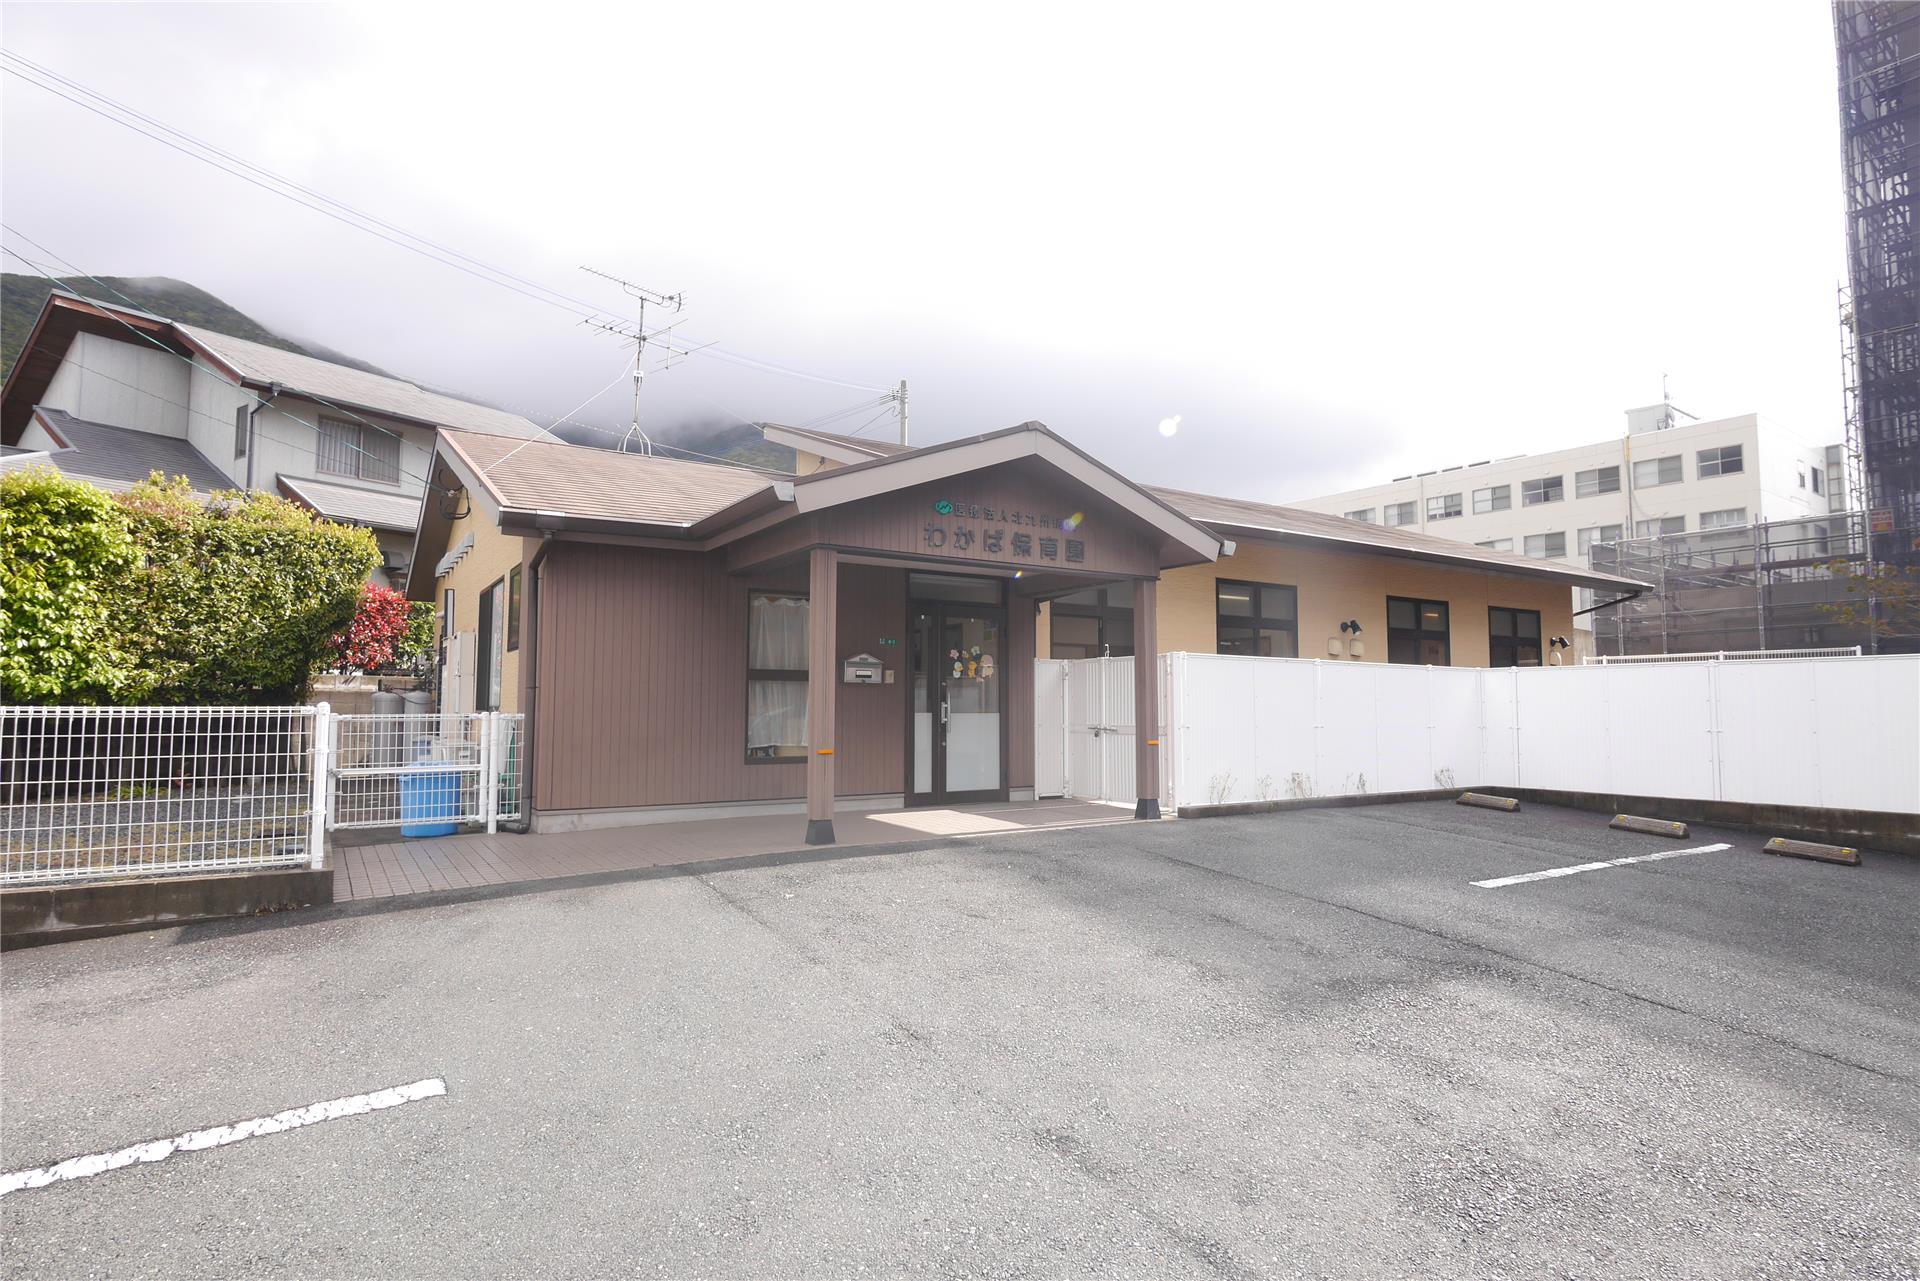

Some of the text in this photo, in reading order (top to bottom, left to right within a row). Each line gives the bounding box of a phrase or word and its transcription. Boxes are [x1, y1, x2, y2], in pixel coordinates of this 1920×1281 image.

[923, 522, 1085, 563] わかば保育園
